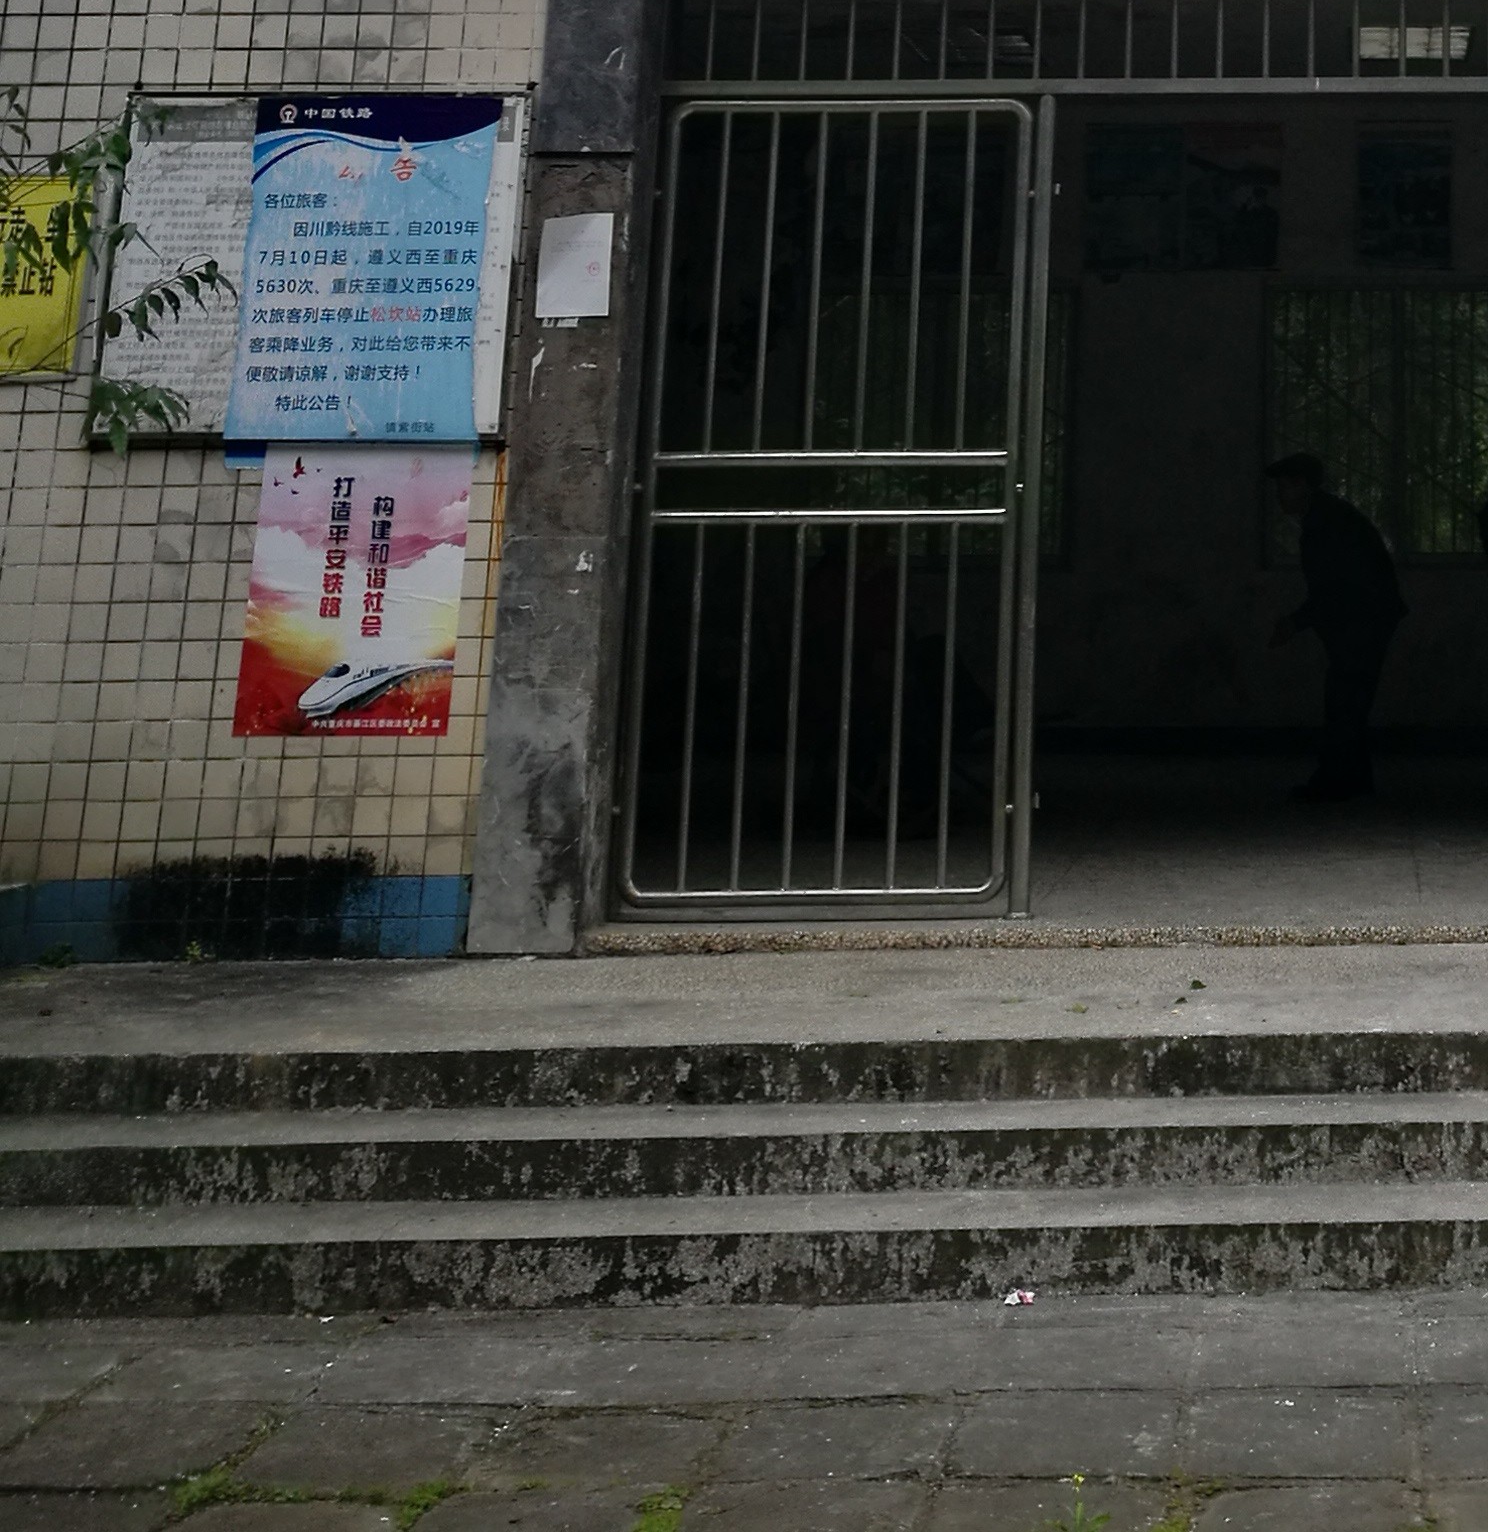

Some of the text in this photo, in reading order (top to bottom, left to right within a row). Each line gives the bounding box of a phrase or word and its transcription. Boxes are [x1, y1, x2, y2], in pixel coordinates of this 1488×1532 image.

[303, 107, 373, 119] 中国铁路
[264, 193, 338, 209] 各位旅客：
[251, 306, 473, 324] 次旅客列车停止松坎站办理旅
[275, 394, 352, 412] 特此公告！
[319, 476, 355, 619] 打造平安铁路
[360, 495, 395, 637] 构建和谐社会
